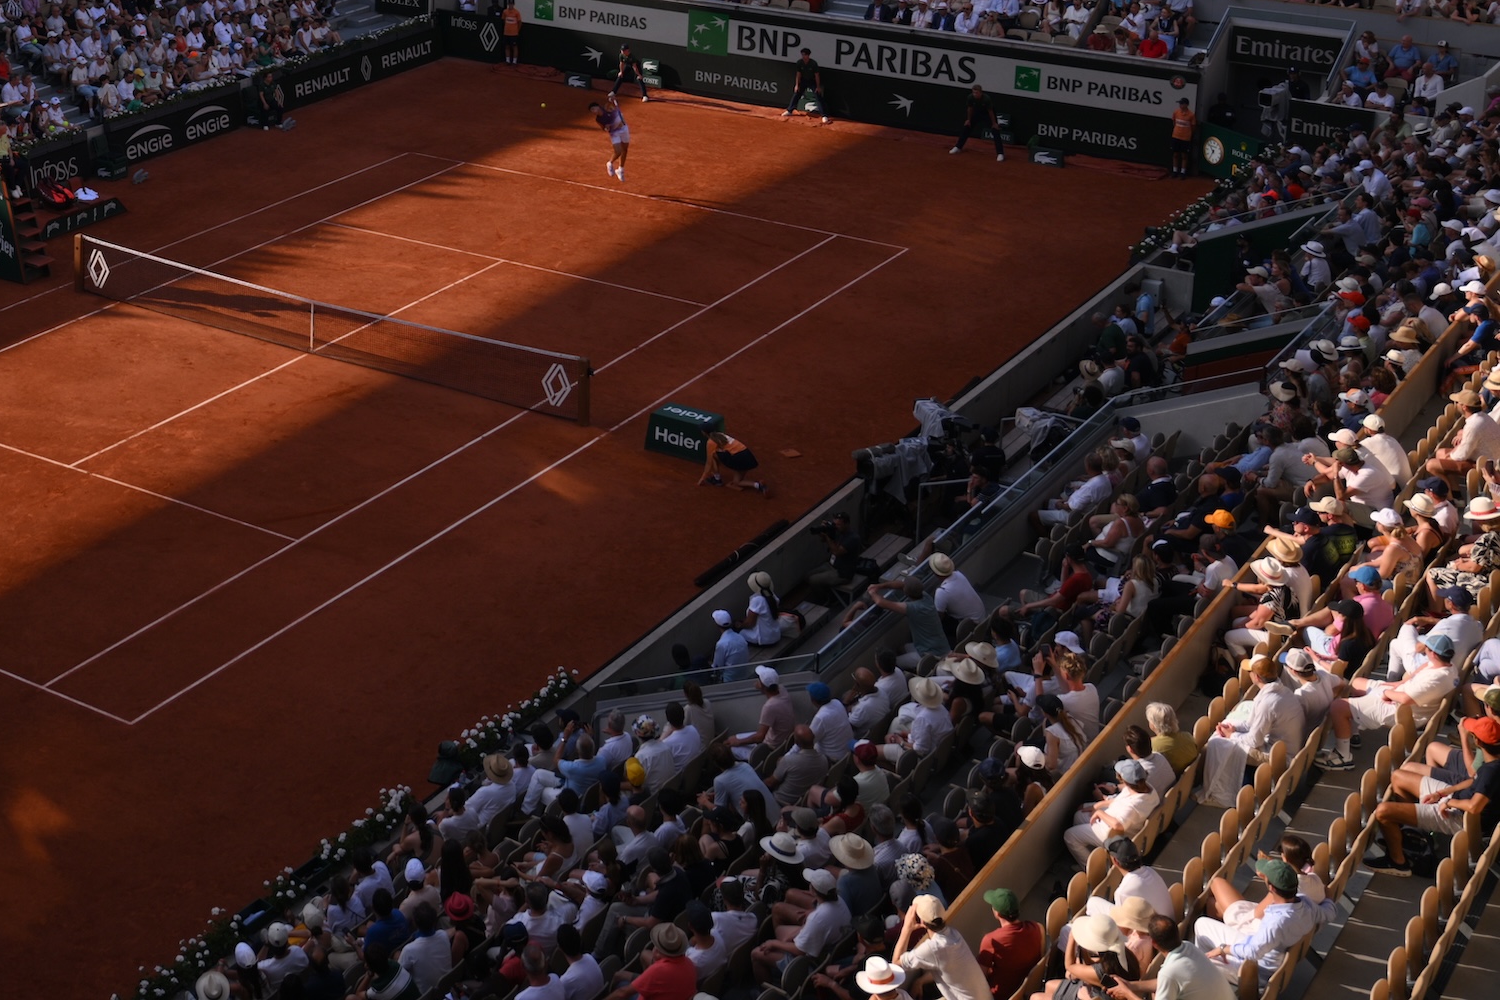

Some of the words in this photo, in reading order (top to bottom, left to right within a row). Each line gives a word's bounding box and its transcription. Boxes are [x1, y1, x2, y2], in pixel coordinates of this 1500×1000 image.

[451, 15, 478, 31] Infosys
[558, 6, 586, 20] BNP
[590, 10, 647, 30] PARIBAS
[382, 40, 432, 69] RENAULT
[737, 25, 801, 58] BNP
[835, 39, 977, 85] PARIBAS
[1236, 35, 1336, 65] Emirates
[295, 67, 350, 98] RENAULT
[643, 76, 659, 85] COSTE
[695, 70, 721, 84] BNP
[724, 74, 778, 94] PARIBAS
[1046, 75, 1083, 94] BNP
[1087, 80, 1163, 106] PARIBAS
[1037, 123, 1069, 139] BNP
[1072, 128, 1138, 150] PARIBAS
[663, 406, 713, 422] Haier
[654, 425, 701, 451] Haier
